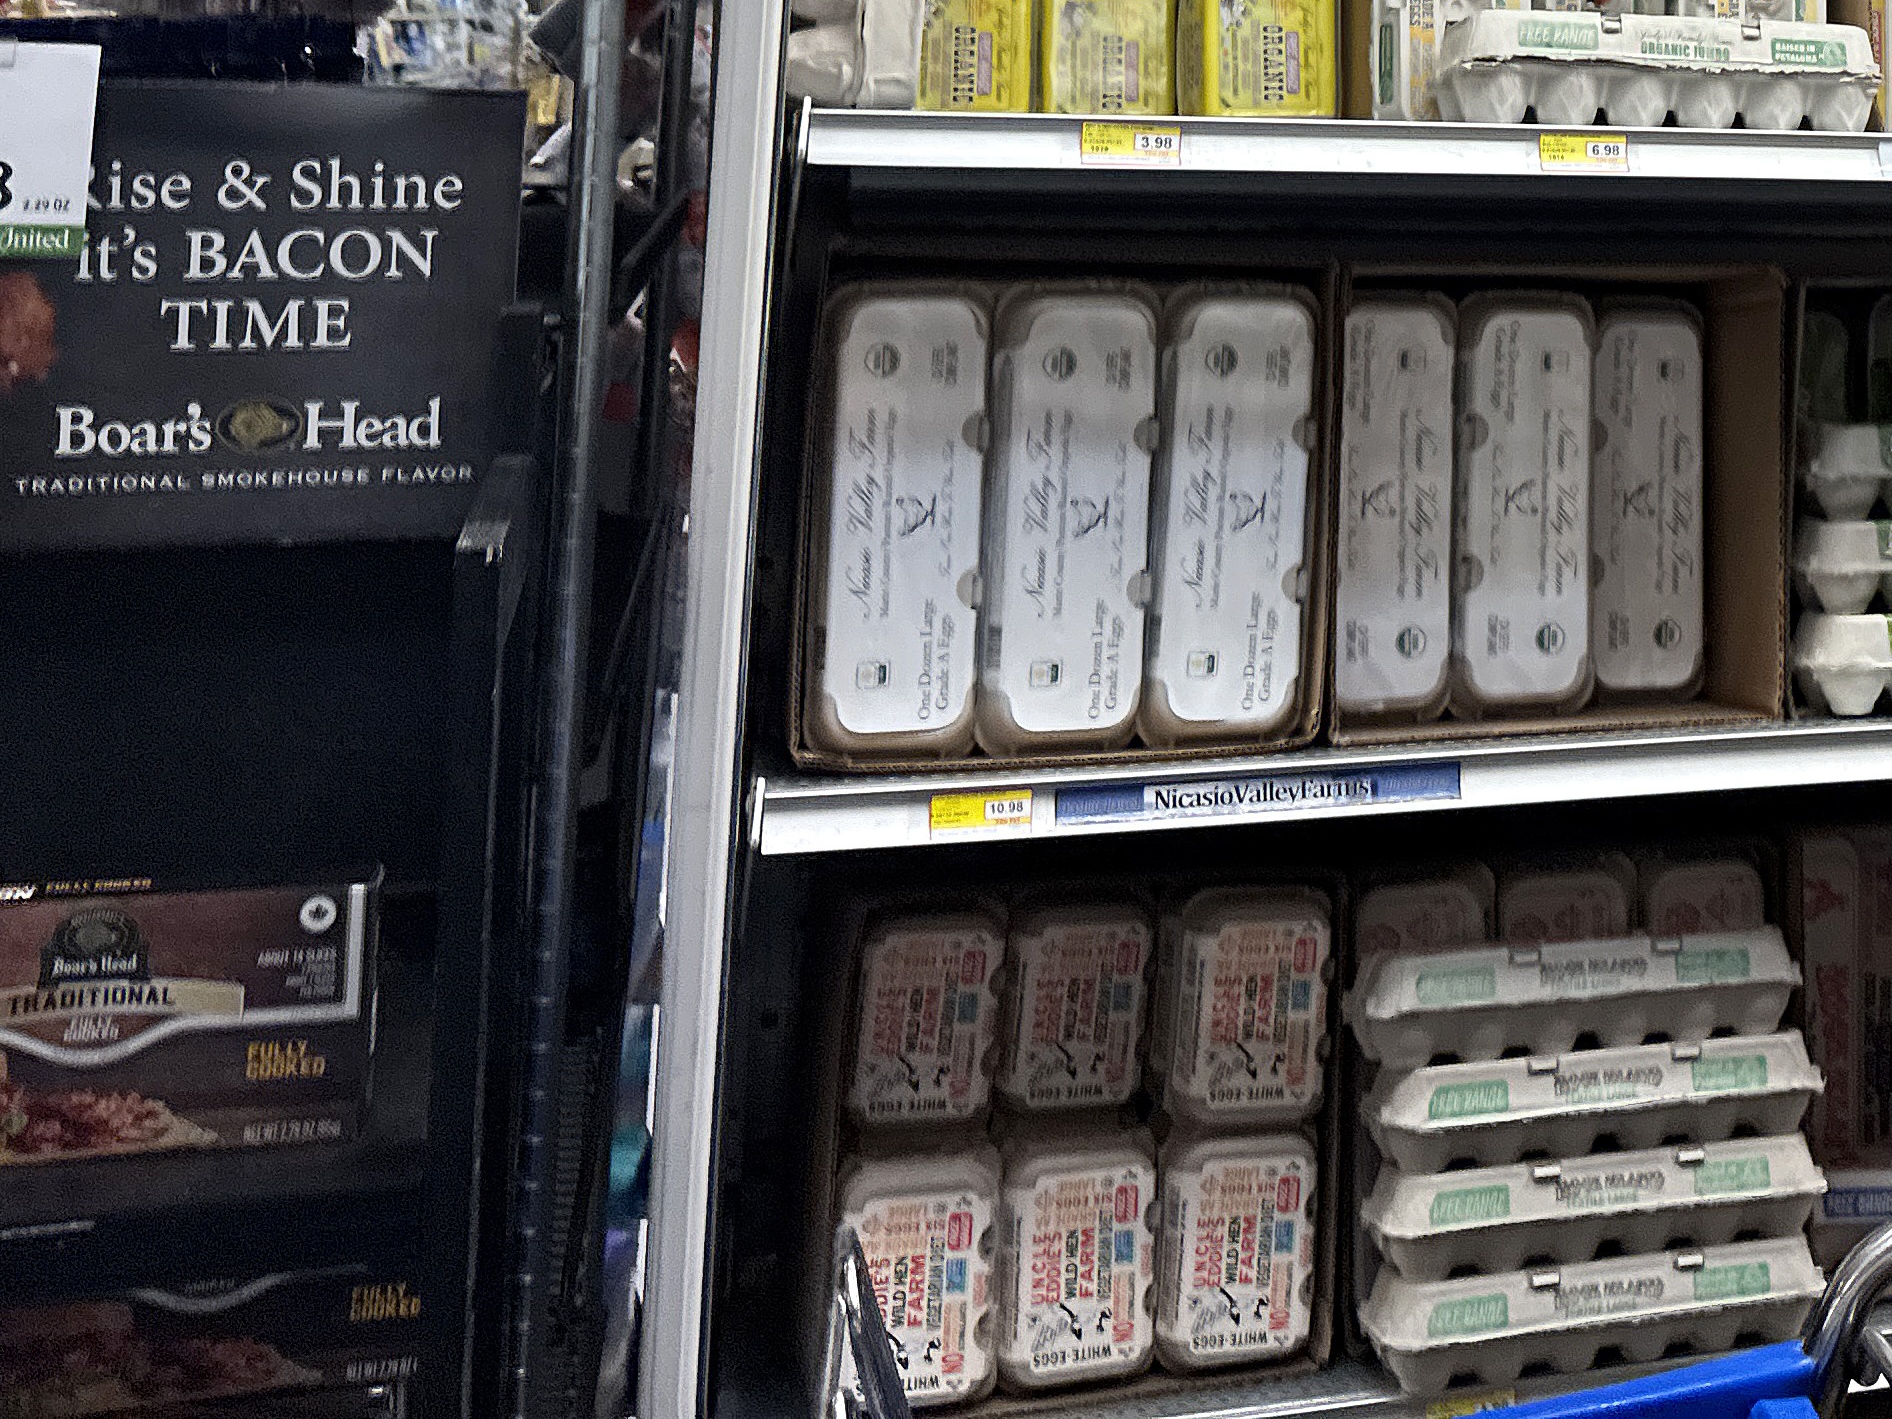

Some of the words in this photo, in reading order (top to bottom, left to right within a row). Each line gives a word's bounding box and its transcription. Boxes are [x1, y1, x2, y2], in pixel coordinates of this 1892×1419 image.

[1263, 26, 1284, 100] ORGANIC
[1141, 136, 1172, 149] 3.98
[1592, 145, 1619, 156] 6.98
[217, 160, 270, 211] &
[290, 158, 463, 211] Shine
[184, 228, 438, 280] BACON
[160, 297, 352, 352] TIME
[54, 401, 213, 458] Boar's
[303, 395, 441, 451] Head
[16, 473, 190, 496] TRADITIONAL
[201, 467, 370, 489] SMOKEHOUSE
[382, 463, 476, 482] FLAVOR
[920, 598, 937, 637] Large
[1091, 598, 1107, 637] Large
[1246, 591, 1261, 630] Large
[1262, 608, 1276, 641] Eggs
[937, 614, 953, 649] Eggs
[1108, 616, 1122, 649] Eggs
[1261, 645, 1272, 656] A
[919, 641, 933, 686] Dozen
[937, 653, 949, 664] A
[1089, 641, 1103, 686] Dozen
[1107, 653, 1118, 664] A
[1244, 633, 1257, 677] Dozen
[935, 668, 949, 710] Grade
[1105, 668, 1118, 709] Grade
[1242, 680, 1254, 710] One
[1259, 659, 1271, 701] Grade
[917, 689, 932, 720] One
[1087, 688, 1101, 719] One
[990, 801, 1024, 814] 10.98
[10, 985, 175, 1016] TRADITIONAL
[1079, 1227, 1094, 1298] FARM
[1194, 1217, 1210, 1288] UNCLE
[1239, 1214, 1257, 1284] FARM
[1031, 1234, 1046, 1305] UNCLE
[907, 1254, 925, 1327] FARM
